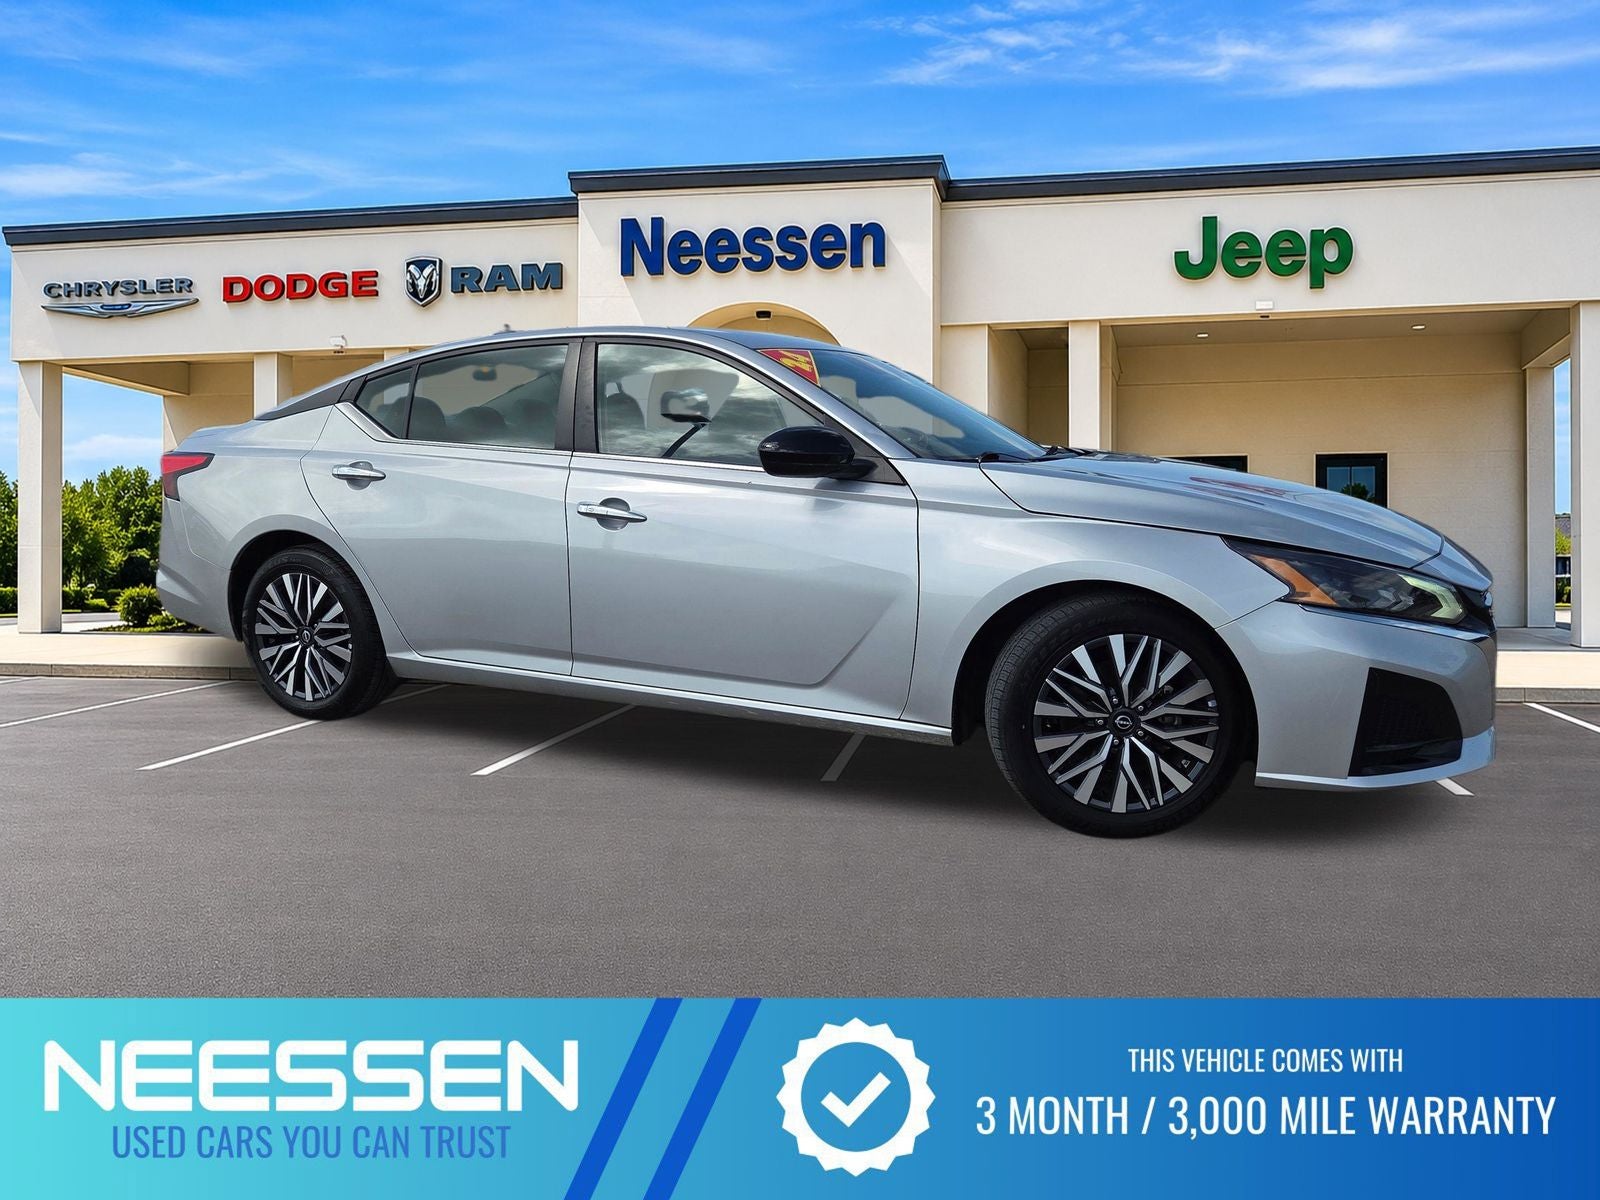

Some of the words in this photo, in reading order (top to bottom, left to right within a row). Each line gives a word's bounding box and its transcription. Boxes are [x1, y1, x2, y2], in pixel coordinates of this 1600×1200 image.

[620, 215, 886, 278] Neessen
[1174, 215, 1354, 289] Jeep
[42, 277, 194, 299] CHRYSLER
[222, 270, 379, 302] DODGE
[450, 262, 563, 293] RAM
